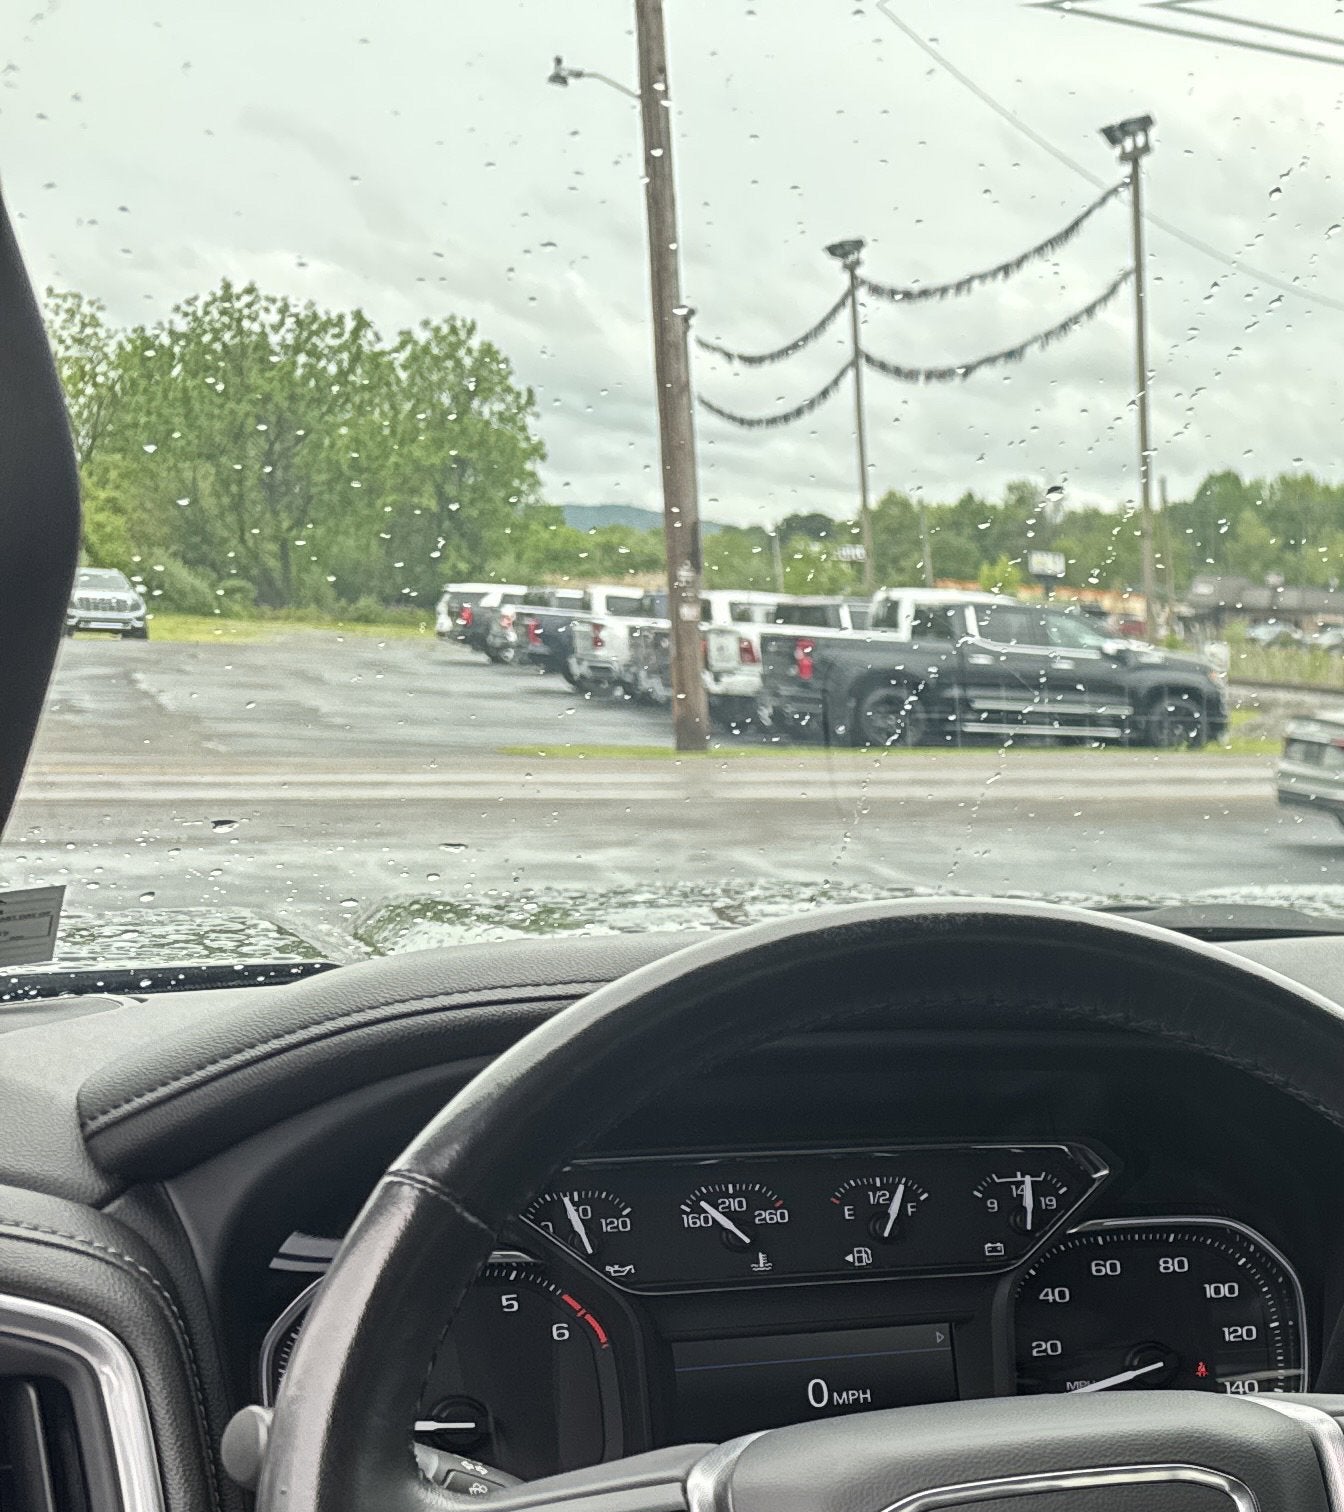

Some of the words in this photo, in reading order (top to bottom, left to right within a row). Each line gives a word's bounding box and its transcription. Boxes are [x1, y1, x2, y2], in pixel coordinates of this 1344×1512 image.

[718, 1198, 747, 1212] 210
[868, 1191, 890, 1204] 1/2
[1040, 1197, 1057, 1210] 19
[844, 1206, 855, 1220] E
[907, 1202, 917, 1216] F
[987, 1199, 998, 1212] 9
[682, 1214, 713, 1228] 160
[754, 1210, 789, 1224] 260
[600, 1218, 631, 1232] 120
[1091, 1260, 1121, 1276] 60
[1159, 1257, 1189, 1273] 80
[1039, 1287, 1070, 1303] 40
[1203, 1282, 1239, 1299] 100
[501, 1294, 519, 1312] 5
[551, 1323, 569, 1341] 6
[1222, 1325, 1257, 1342] 120
[1032, 1340, 1062, 1357] 20
[807, 1378, 829, 1408] 0
[833, 1389, 872, 1406] MPH
[1224, 1380, 1259, 1395] 140
